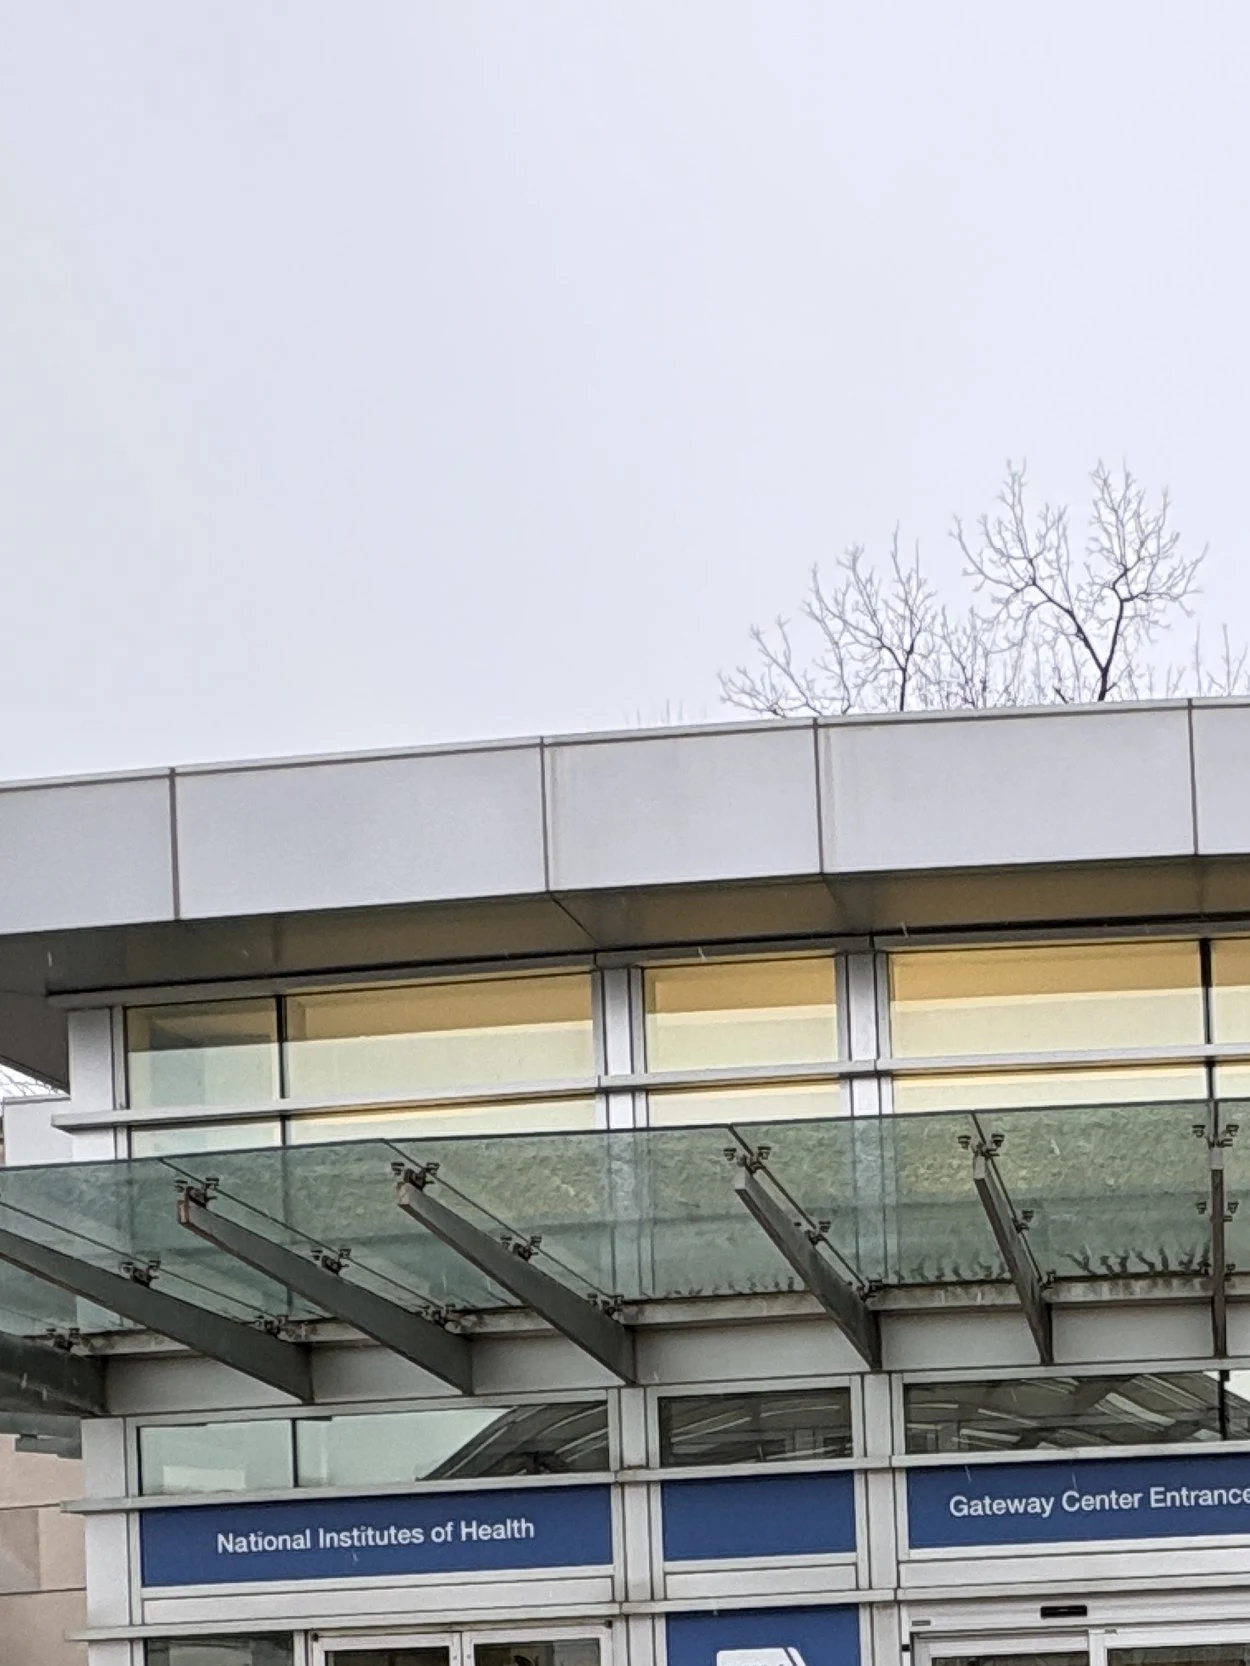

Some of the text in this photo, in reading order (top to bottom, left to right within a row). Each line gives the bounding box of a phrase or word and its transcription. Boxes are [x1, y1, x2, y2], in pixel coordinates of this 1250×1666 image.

[949, 1494, 1054, 1518] Gateway
[1061, 1489, 1143, 1512] Center
[217, 1518, 534, 1553] National Institutes of Health
